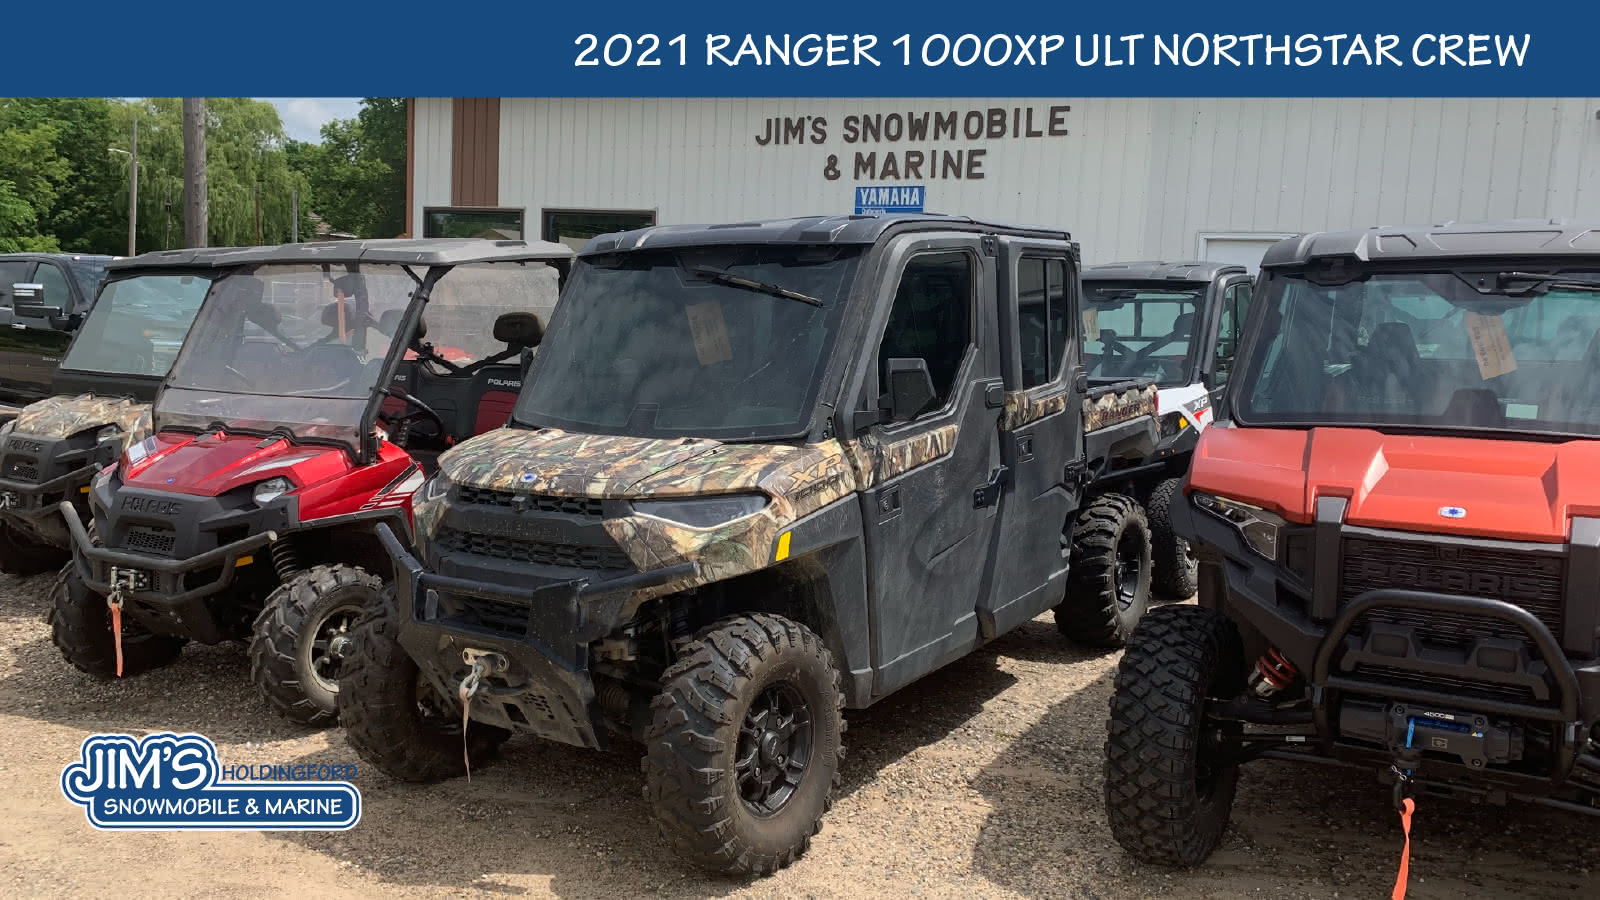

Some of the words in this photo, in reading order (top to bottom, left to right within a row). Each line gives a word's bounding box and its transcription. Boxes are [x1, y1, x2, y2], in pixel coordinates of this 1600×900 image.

[755, 116, 828, 146] JIM'S
[843, 105, 1071, 144] SNOWMOBILE
[824, 154, 841, 180] &
[854, 149, 987, 181] MARINE
[860, 187, 921, 206] YAMAHA
[488, 378, 521, 387] POLARIS
[1101, 403, 1141, 421] RANGER
[1194, 397, 1208, 411] XP
[788, 453, 841, 491] XP
[121, 496, 184, 515] POLARIS
[1361, 561, 1544, 600] POLARIS
